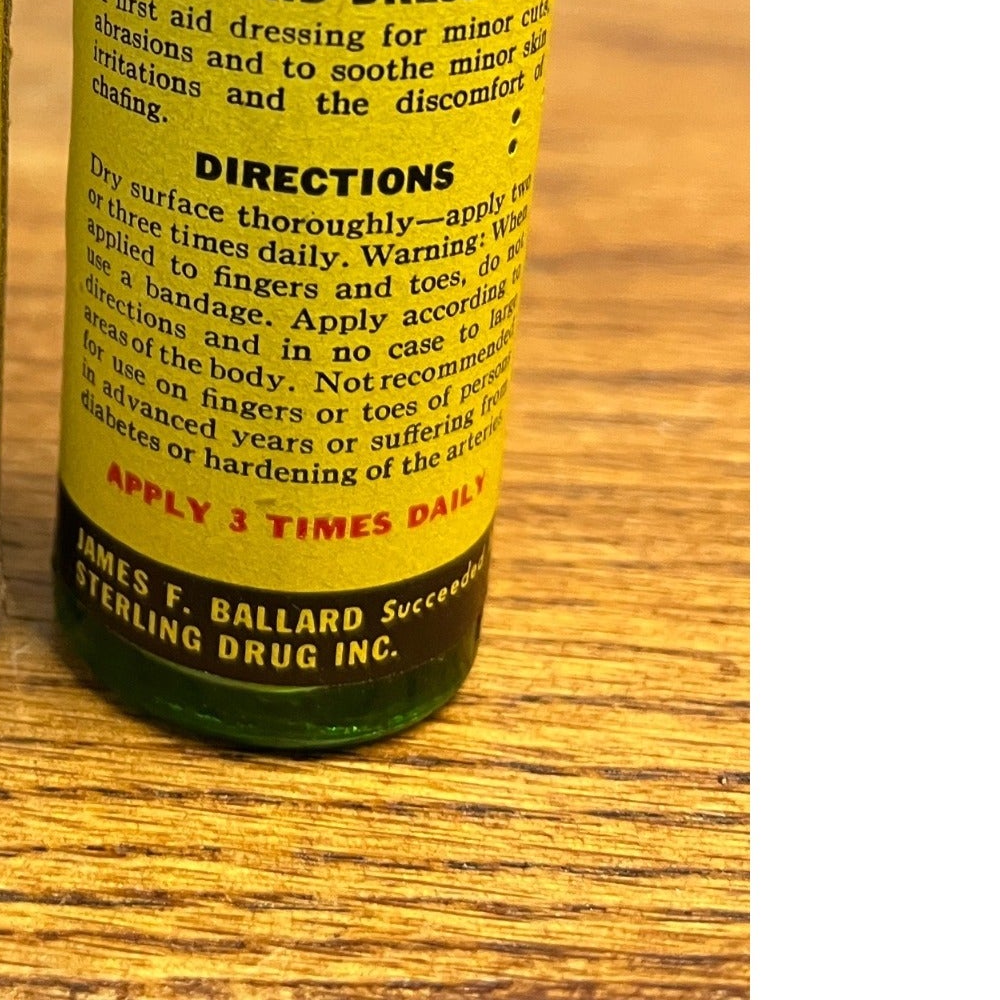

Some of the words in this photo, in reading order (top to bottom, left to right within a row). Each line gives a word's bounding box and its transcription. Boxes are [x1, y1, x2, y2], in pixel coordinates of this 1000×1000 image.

[94, 13, 194, 63] abrasions
[207, 51, 263, 75] and
[282, 56, 316, 80] to
[331, 55, 435, 82] soothe
[449, 45, 517, 76] minor
[523, 27, 547, 58] skin
[170, 6, 212, 33] aid
[230, 14, 366, 52] dressing
[382, 22, 427, 47] for
[442, 16, 514, 43] minor
[92, 75, 168, 123] chafing.
[93, 40, 201, 98] irritations
[227, 86, 286, 112] and
[316, 90, 369, 116] the
[395, 70, 525, 115] discomfort
[534, 53, 545, 81] of
[90, 152, 122, 190] Dry
[131, 181, 224, 223] surface
[195, 151, 455, 197] DIRECTIONS
[87, 218, 155, 267] applied
[171, 255, 198, 279] to
[214, 265, 318, 300] fingers
[335, 275, 392, 300] and
[410, 270, 466, 295] toes,
[478, 254, 500, 277] do
[507, 232, 524, 262] not
[88, 188, 103, 210] or
[108, 198, 162, 238] three
[170, 223, 249, 259] times
[258, 240, 349, 271] daily.
[360, 232, 485, 268] Warning:
[492, 205, 528, 241] When
[85, 273, 186, 339] directions
[204, 329, 260, 355] and
[281, 337, 312, 361] in
[332, 345, 371, 362] no
[388, 335, 445, 360] case
[459, 322, 479, 343] to
[87, 245, 111, 276] use
[120, 270, 132, 289] a
[146, 275, 273, 326] bandage.
[290, 308, 388, 335] Apply
[402, 279, 507, 327] according
[511, 264, 521, 284] to
[83, 329, 104, 361] for
[112, 355, 146, 385] use
[156, 378, 188, 402] on
[201, 387, 303, 423] fingers
[316, 407, 349, 424] or
[362, 400, 418, 423] toes
[428, 384, 452, 411] of
[84, 305, 128, 347] areas
[131, 337, 154, 358] of
[159, 346, 202, 374] the
[210, 357, 295, 392] body.
[314, 371, 374, 393] Not
[81, 389, 160, 451] diabetes
[167, 442, 196, 464] or
[203, 447, 358, 487] hardening
[366, 457, 394, 480] of
[401, 450, 440, 476] the
[82, 357, 96, 386] in
[102, 380, 216, 440] advanced
[232, 429, 314, 455] years
[327, 437, 358, 454] or
[371, 408, 475, 452] suffering
[107, 461, 211, 525] APPLY
[229, 508, 248, 533] 3
[265, 511, 393, 540] TIMES
[407, 471, 486, 529] DAILY
[76, 560, 201, 652] STERLING
[217, 634, 317, 669] DRUG
[335, 635, 398, 666] INC.
[77, 527, 149, 596] JAMES
[166, 583, 191, 615] F.
[210, 596, 363, 634] BALLARD
[380, 544, 485, 624] Succeeded
